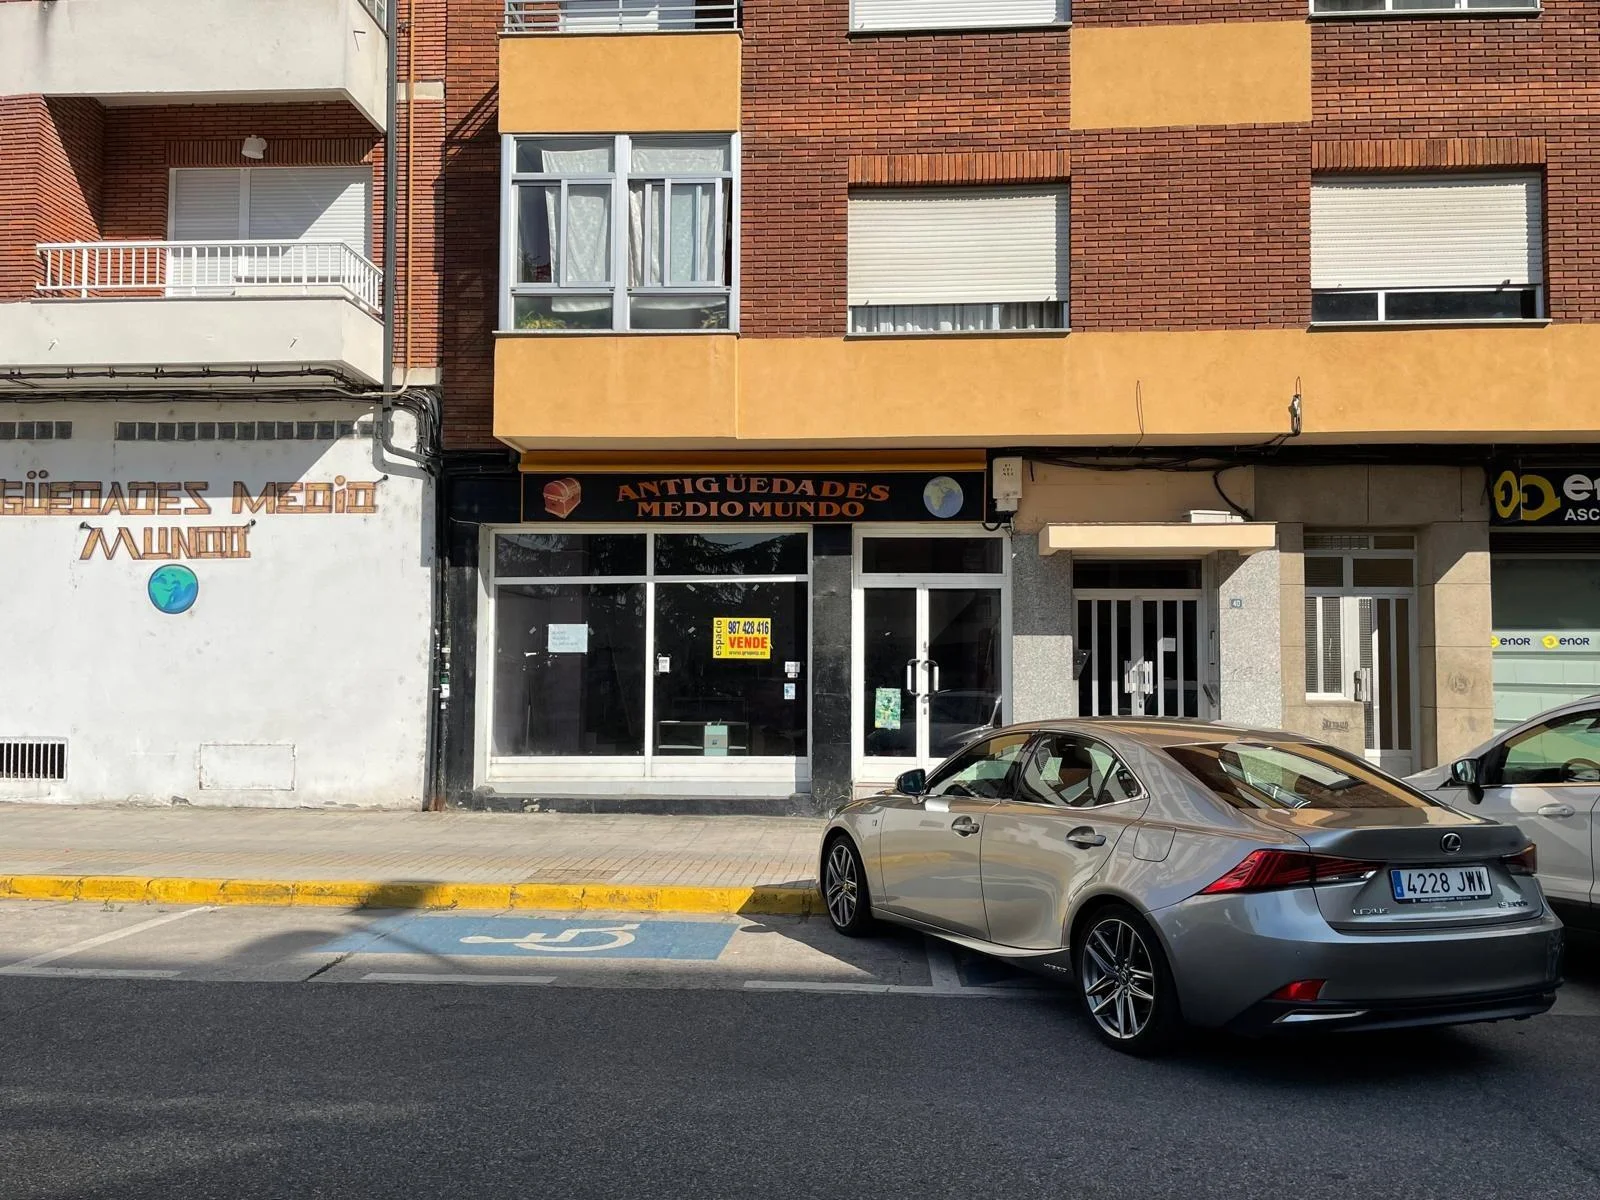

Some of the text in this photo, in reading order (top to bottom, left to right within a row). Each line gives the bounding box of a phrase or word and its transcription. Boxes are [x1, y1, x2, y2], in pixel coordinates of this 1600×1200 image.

[617, 474, 890, 502] ANTIGÜEDADES
[1563, 474, 1600, 501] e
[637, 501, 865, 517] MEDIO MUNDO
[79, 526, 251, 561] MUNDO
[715, 620, 725, 656] espacio
[728, 621, 769, 635] 987 428 416
[728, 636, 768, 649] VENDE
[1407, 870, 1487, 894] 4228 JWK
